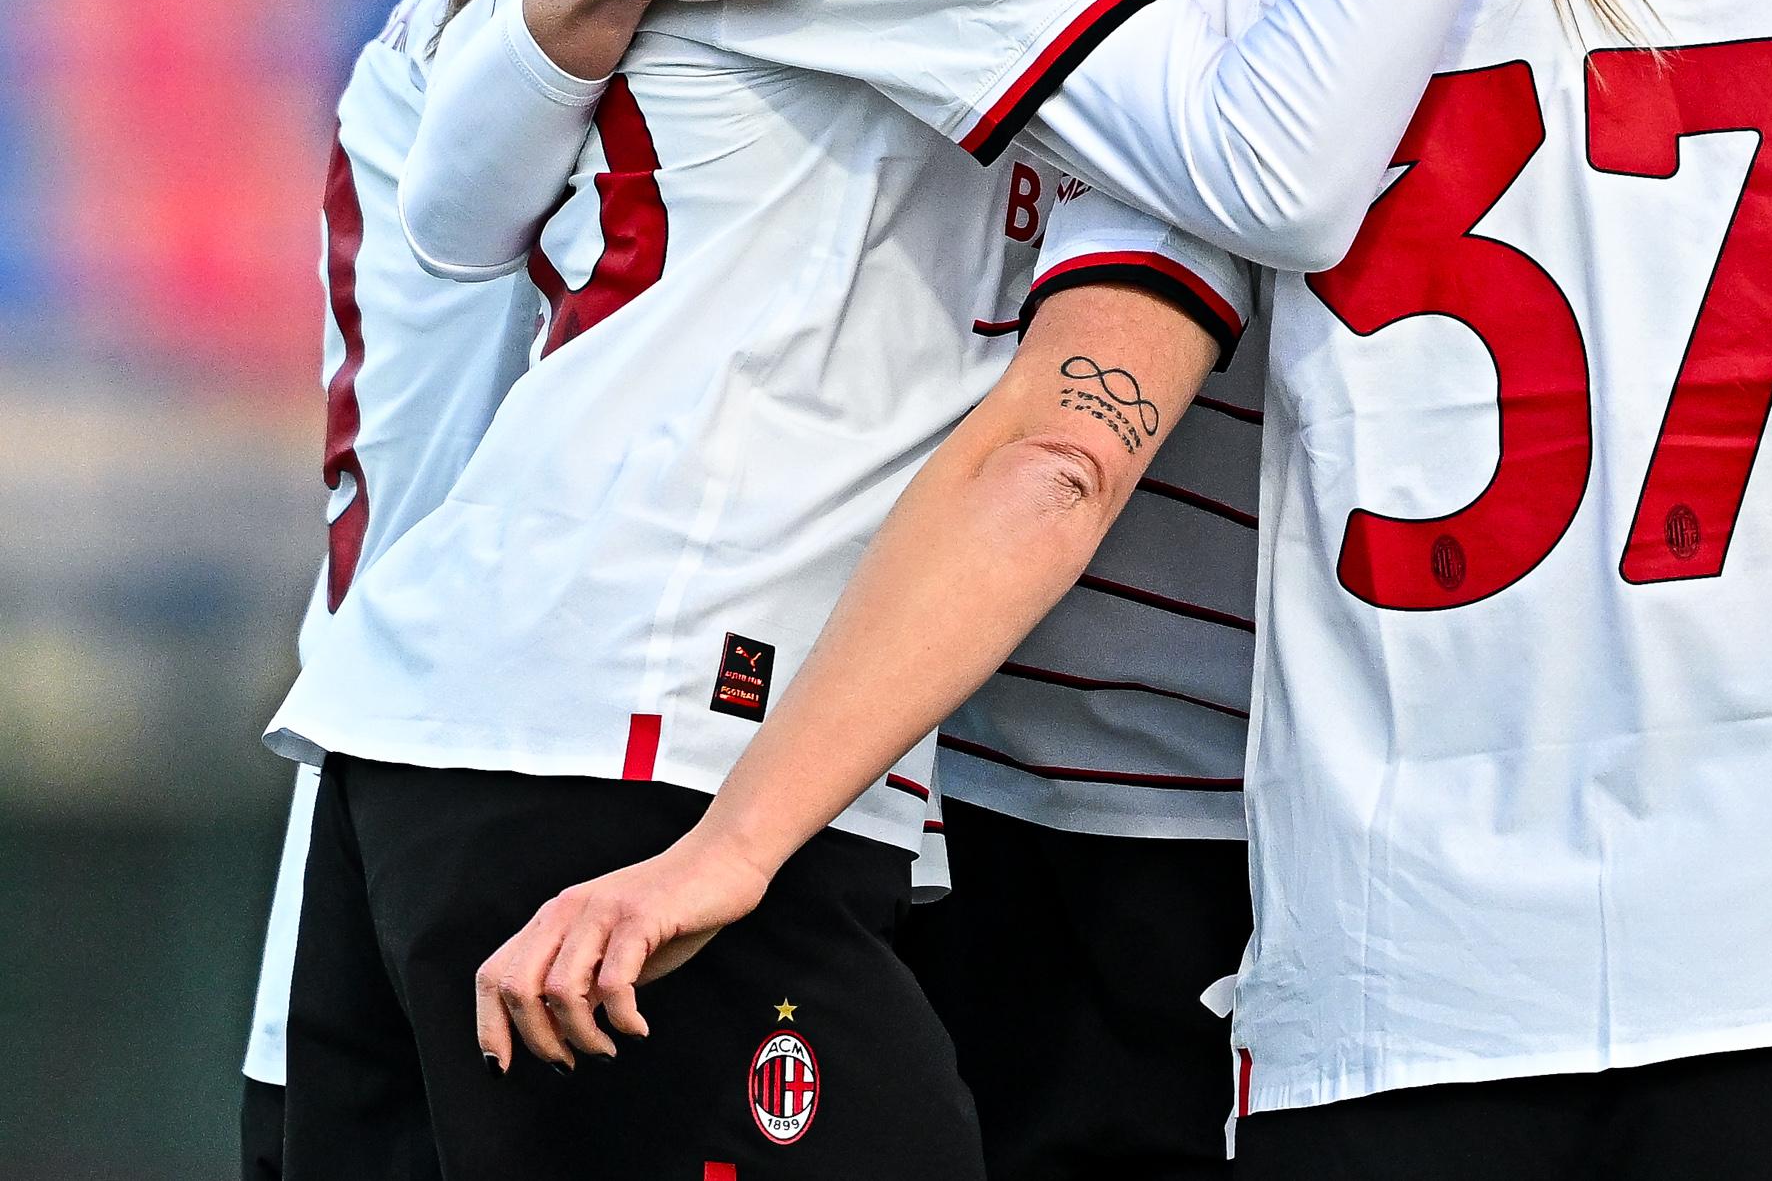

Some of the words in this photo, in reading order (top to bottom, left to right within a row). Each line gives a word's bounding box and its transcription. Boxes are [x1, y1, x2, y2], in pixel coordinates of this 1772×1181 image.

[1005, 161, 1046, 250] B
[765, 1038, 805, 1059] ACM
[767, 1118, 801, 1131] 1899
